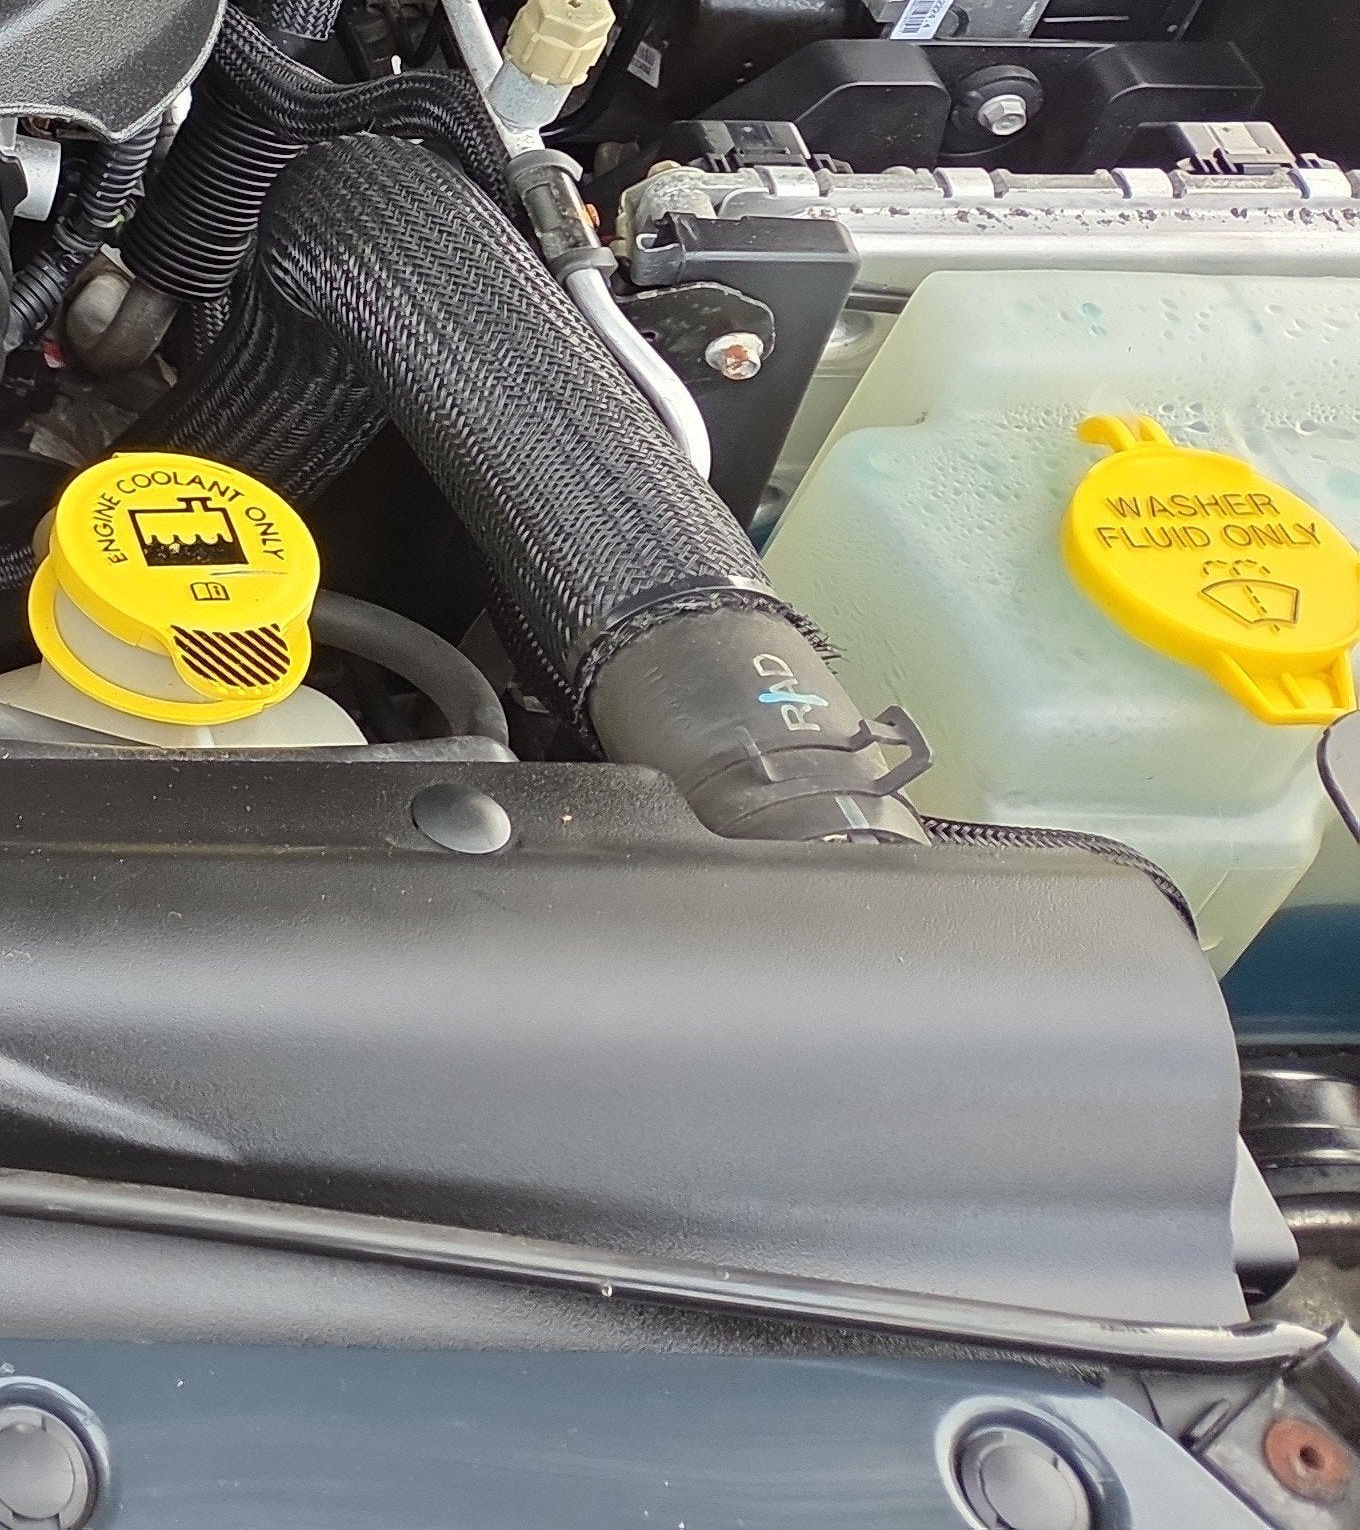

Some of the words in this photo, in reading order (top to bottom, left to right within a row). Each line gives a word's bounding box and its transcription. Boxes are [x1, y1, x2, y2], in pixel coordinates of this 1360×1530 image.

[93, 492, 128, 566] ENGINE
[116, 470, 245, 503] COOLANT
[244, 506, 286, 561] ONLY
[1106, 493, 1281, 518] WASHER
[1095, 526, 1212, 549] FLUID
[1221, 522, 1322, 548] ONLY
